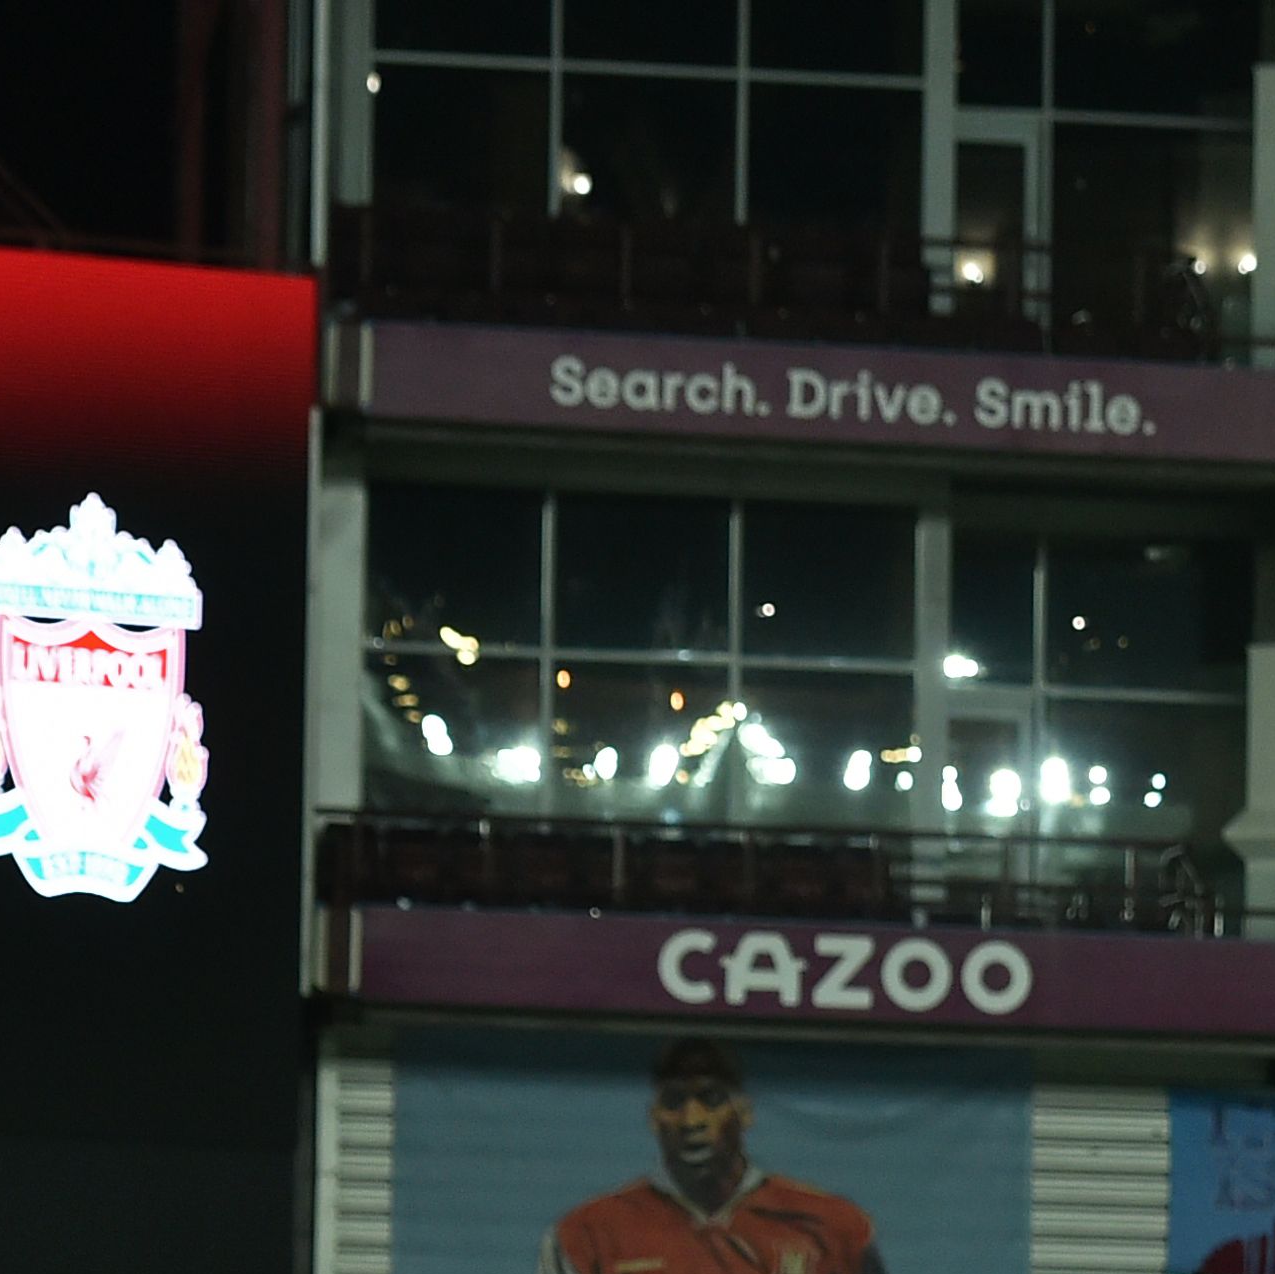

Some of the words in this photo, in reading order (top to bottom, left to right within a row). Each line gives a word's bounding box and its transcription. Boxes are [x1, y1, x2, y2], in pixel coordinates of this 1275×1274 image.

[549, 354, 772, 418] Search.
[786, 366, 957, 428] Drive.
[973, 375, 1157, 437] Smile.
[657, 928, 1034, 1015] CAZOO
